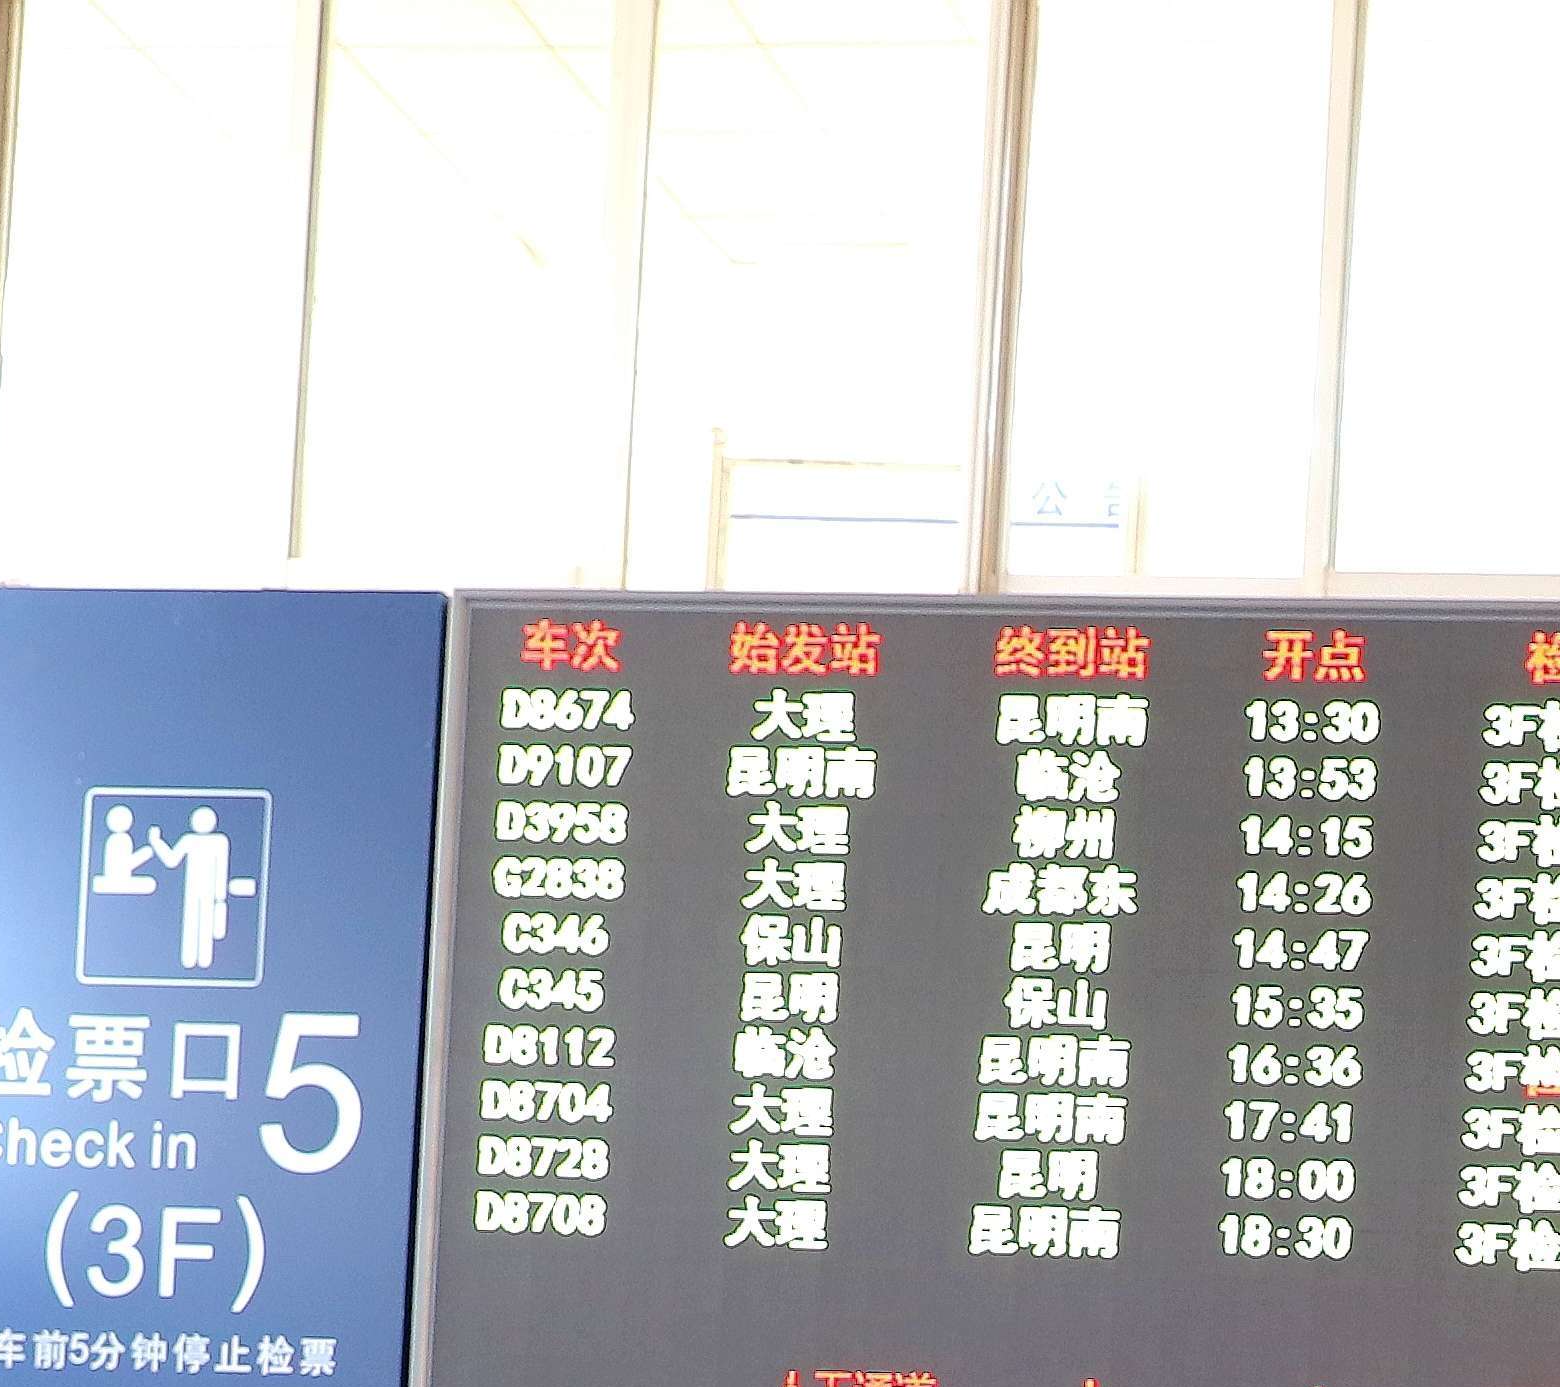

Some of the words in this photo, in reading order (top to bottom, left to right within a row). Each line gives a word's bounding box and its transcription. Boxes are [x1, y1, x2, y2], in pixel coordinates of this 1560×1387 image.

[522, 618, 619, 673] 车次
[729, 621, 880, 677] 始发站
[995, 625, 1150, 681] 终到站
[1263, 629, 1364, 683] 开点
[500, 687, 635, 732] D8674
[750, 687, 856, 743] 大理
[996, 693, 1149, 748] 昆明南
[1246, 699, 1379, 744] 13:30
[498, 743, 632, 789] D9107
[726, 744, 877, 800] 昆明南
[1016, 747, 1121, 804] 临沧
[1244, 755, 1377, 802] 13:53
[496, 800, 628, 845] D3958
[745, 799, 849, 856] 大理
[1012, 804, 1115, 861] 柳州
[1240, 814, 1373, 859] 14:15
[492, 855, 625, 901] G2838
[741, 857, 845, 912] 大理
[982, 858, 1137, 918] 成都东
[1237, 871, 1372, 916] 14:26
[502, 911, 609, 957] C346
[740, 912, 842, 969] 保山
[1010, 921, 1111, 974] 昆明
[1234, 927, 1369, 972] 14:47
[499, 967, 604, 1013] C345
[740, 971, 839, 1025] 昆明
[1004, 975, 1107, 1031] 保山
[1232, 984, 1363, 1031] 15:35
[484, 1023, 615, 1068] D8112
[734, 1025, 836, 1081] 临沧
[978, 1033, 1131, 1089] 昆明南
[1228, 1043, 1362, 1088] 16:36
[259, 1012, 363, 1175] 5
[480, 1079, 613, 1124] D8704
[729, 1081, 833, 1138] 大理
[974, 1091, 1127, 1146] 昆明南
[1224, 1099, 1352, 1144] 17:41
[149, 1119, 198, 1170] in
[478, 1134, 609, 1181] D8728
[728, 1138, 831, 1194] 大理
[998, 1146, 1098, 1202] 昆明
[1222, 1157, 1355, 1203] 18:00
[43, 1190, 267, 1315] (3F)
[473, 1189, 607, 1237] D8708
[724, 1194, 828, 1251] 大理
[968, 1204, 1121, 1260] 昆明南
[1219, 1213, 1352, 1260] 18:30
